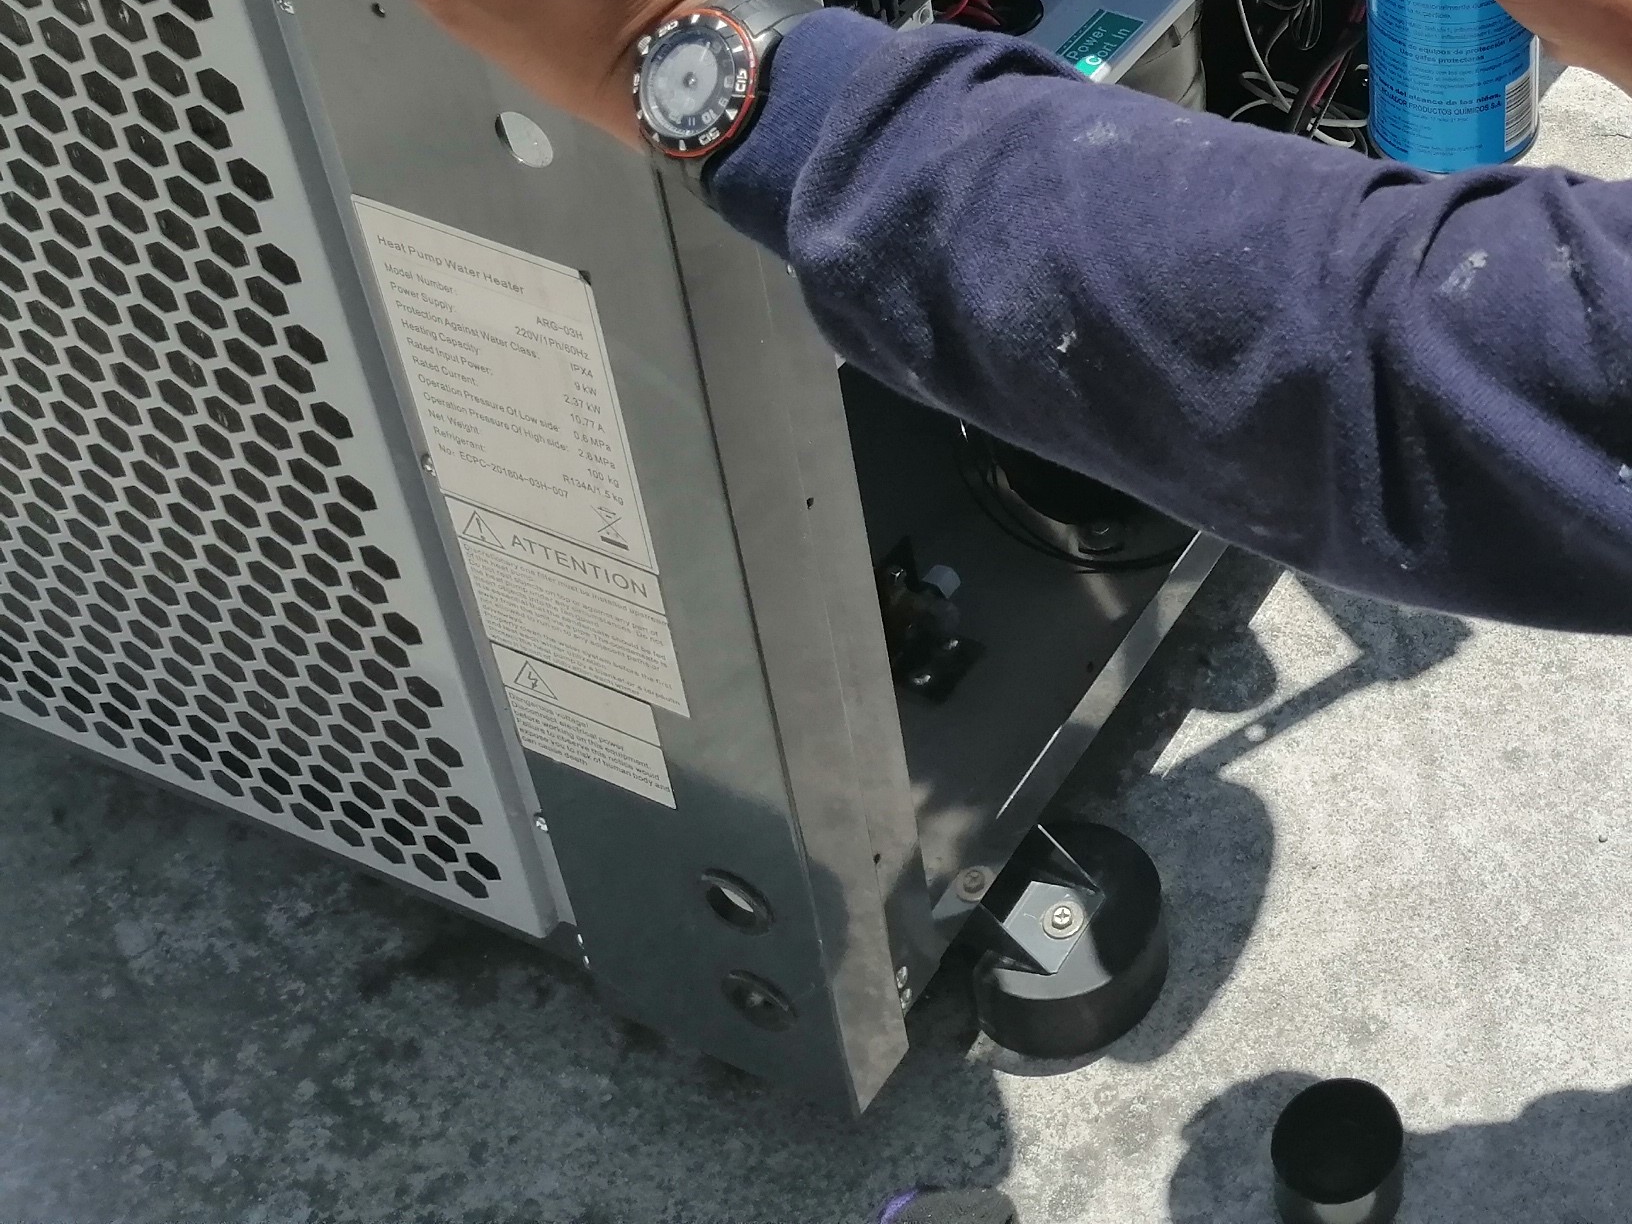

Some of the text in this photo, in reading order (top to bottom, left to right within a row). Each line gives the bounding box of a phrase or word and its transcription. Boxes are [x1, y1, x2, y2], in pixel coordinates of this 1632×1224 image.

[1066, 26, 1107, 60] Power
[1112, 28, 1130, 40] In
[1409, 102, 1452, 116] PRODUCTOS
[376, 234, 525, 295] Heat Pump Water Heater
[383, 262, 413, 280] Model
[389, 280, 419, 299] Power
[395, 299, 443, 324] Protection
[442, 316, 479, 339] Against
[479, 329, 508, 348] Water
[400, 318, 438, 341] Heating
[581, 383, 597, 396] kW
[406, 336, 434, 354] Rated
[435, 347, 460, 365] Input
[586, 401, 602, 415] kW
[411, 354, 439, 372] Rated
[595, 422, 605, 433] A
[417, 372, 463, 398] Operation
[462, 389, 505, 412] Pressure
[518, 410, 538, 424] Low
[589, 435, 611, 452] MPa
[422, 390, 468, 416] Operation
[467, 407, 510, 430] Pressure
[523, 427, 545, 445] High
[593, 453, 615, 470] MPa
[427, 408, 445, 422] Net
[607, 474, 620, 488] kg
[511, 534, 648, 598] ATTENTION
